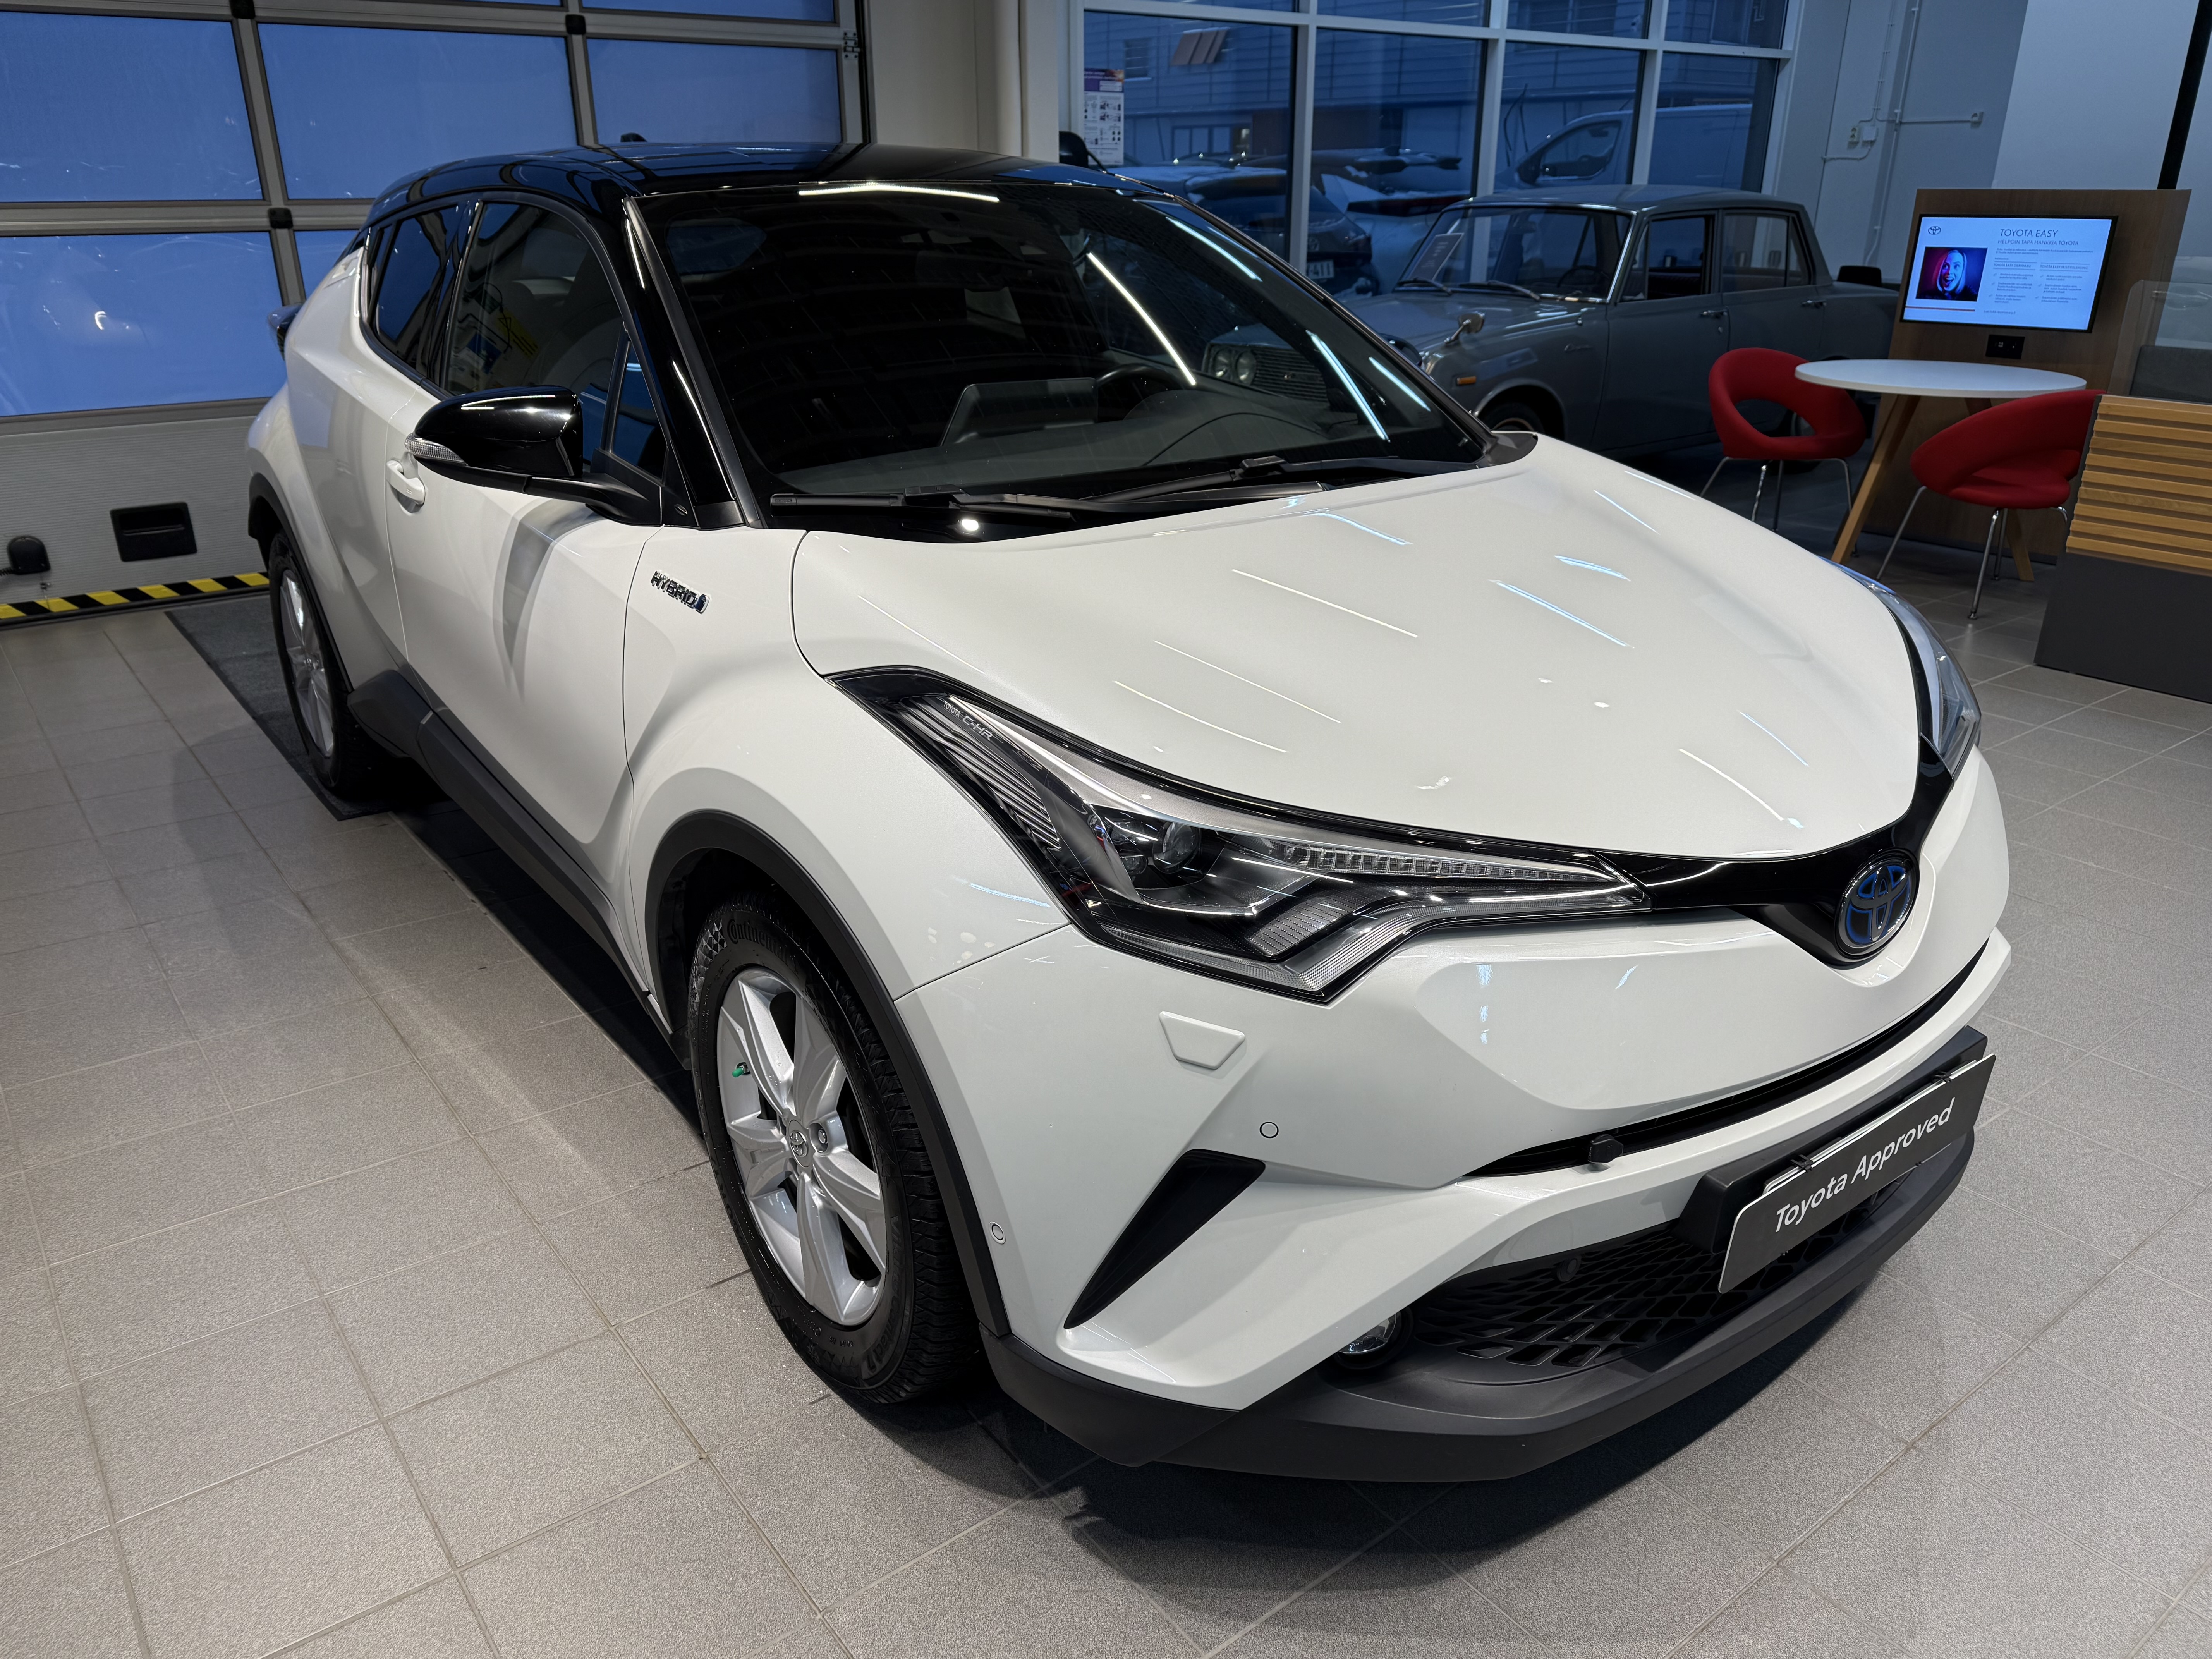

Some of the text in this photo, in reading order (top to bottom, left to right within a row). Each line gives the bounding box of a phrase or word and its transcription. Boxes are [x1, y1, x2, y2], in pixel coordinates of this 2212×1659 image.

[2000, 229, 2033, 237] TOYOTA
[651, 571, 698, 609] HYBRID
[943, 701, 993, 741] TOYOTA C-HR
[727, 919, 788, 963] Continental
[1776, 1097, 1955, 1233] Toyota Approved
